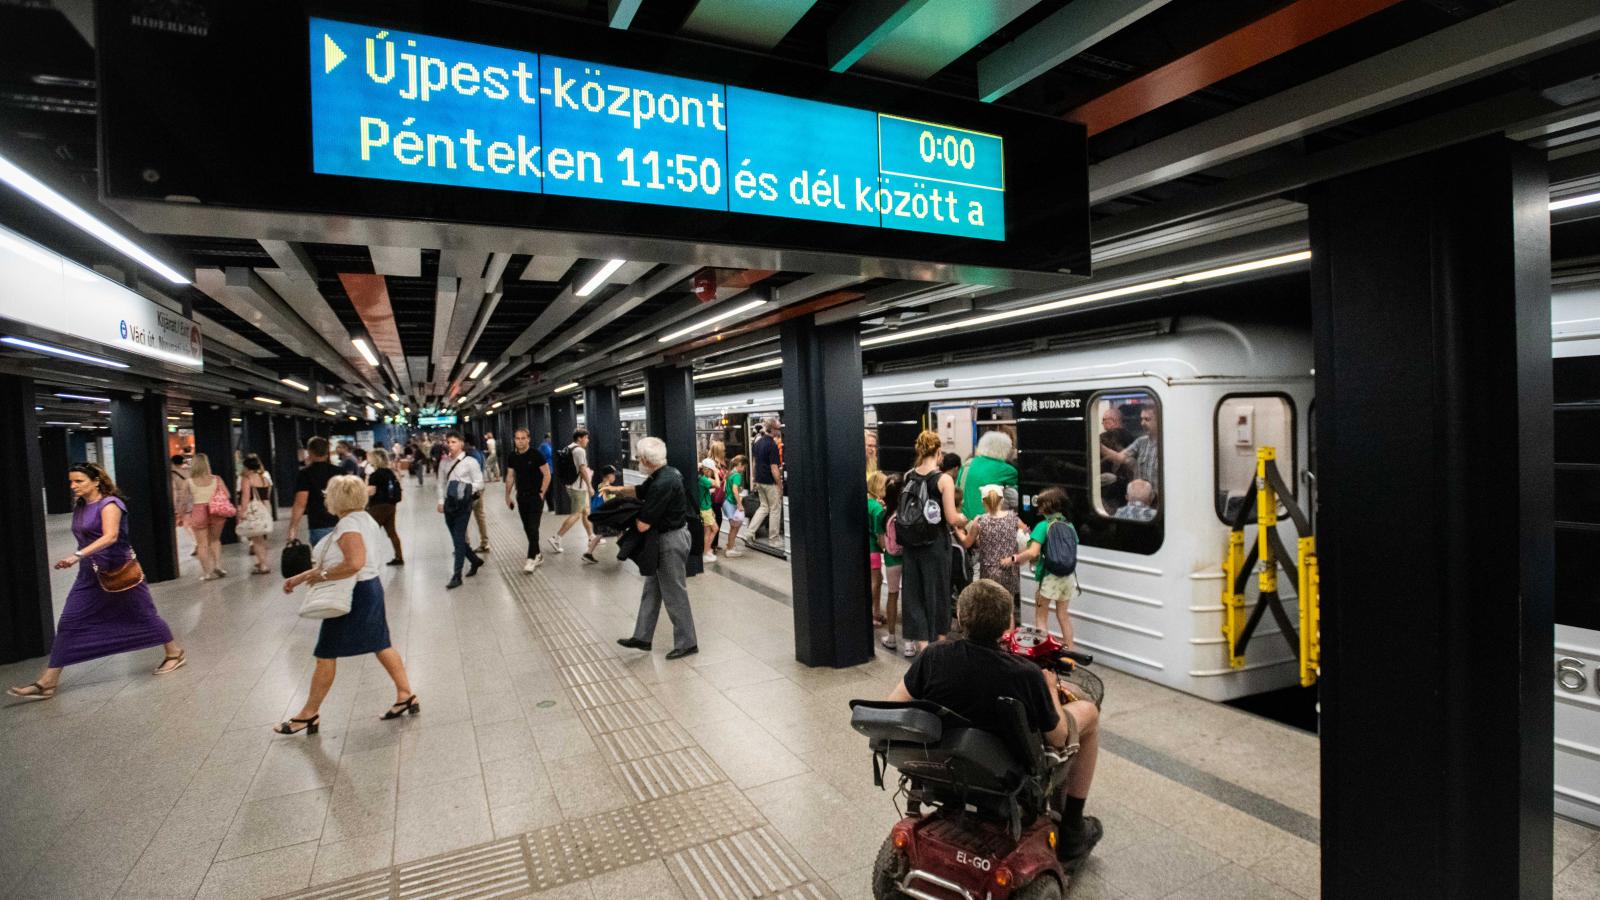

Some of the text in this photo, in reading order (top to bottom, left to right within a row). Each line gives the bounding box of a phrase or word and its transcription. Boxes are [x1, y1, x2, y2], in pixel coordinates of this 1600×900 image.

[365, 30, 726, 131] Újpest-központ
[360, 116, 985, 227] Pénteken 11:50 és dél között a
[919, 130, 975, 170] 0:00
[1038, 399, 1081, 410] BUDAPEST
[1557, 656, 1600, 700] 6
